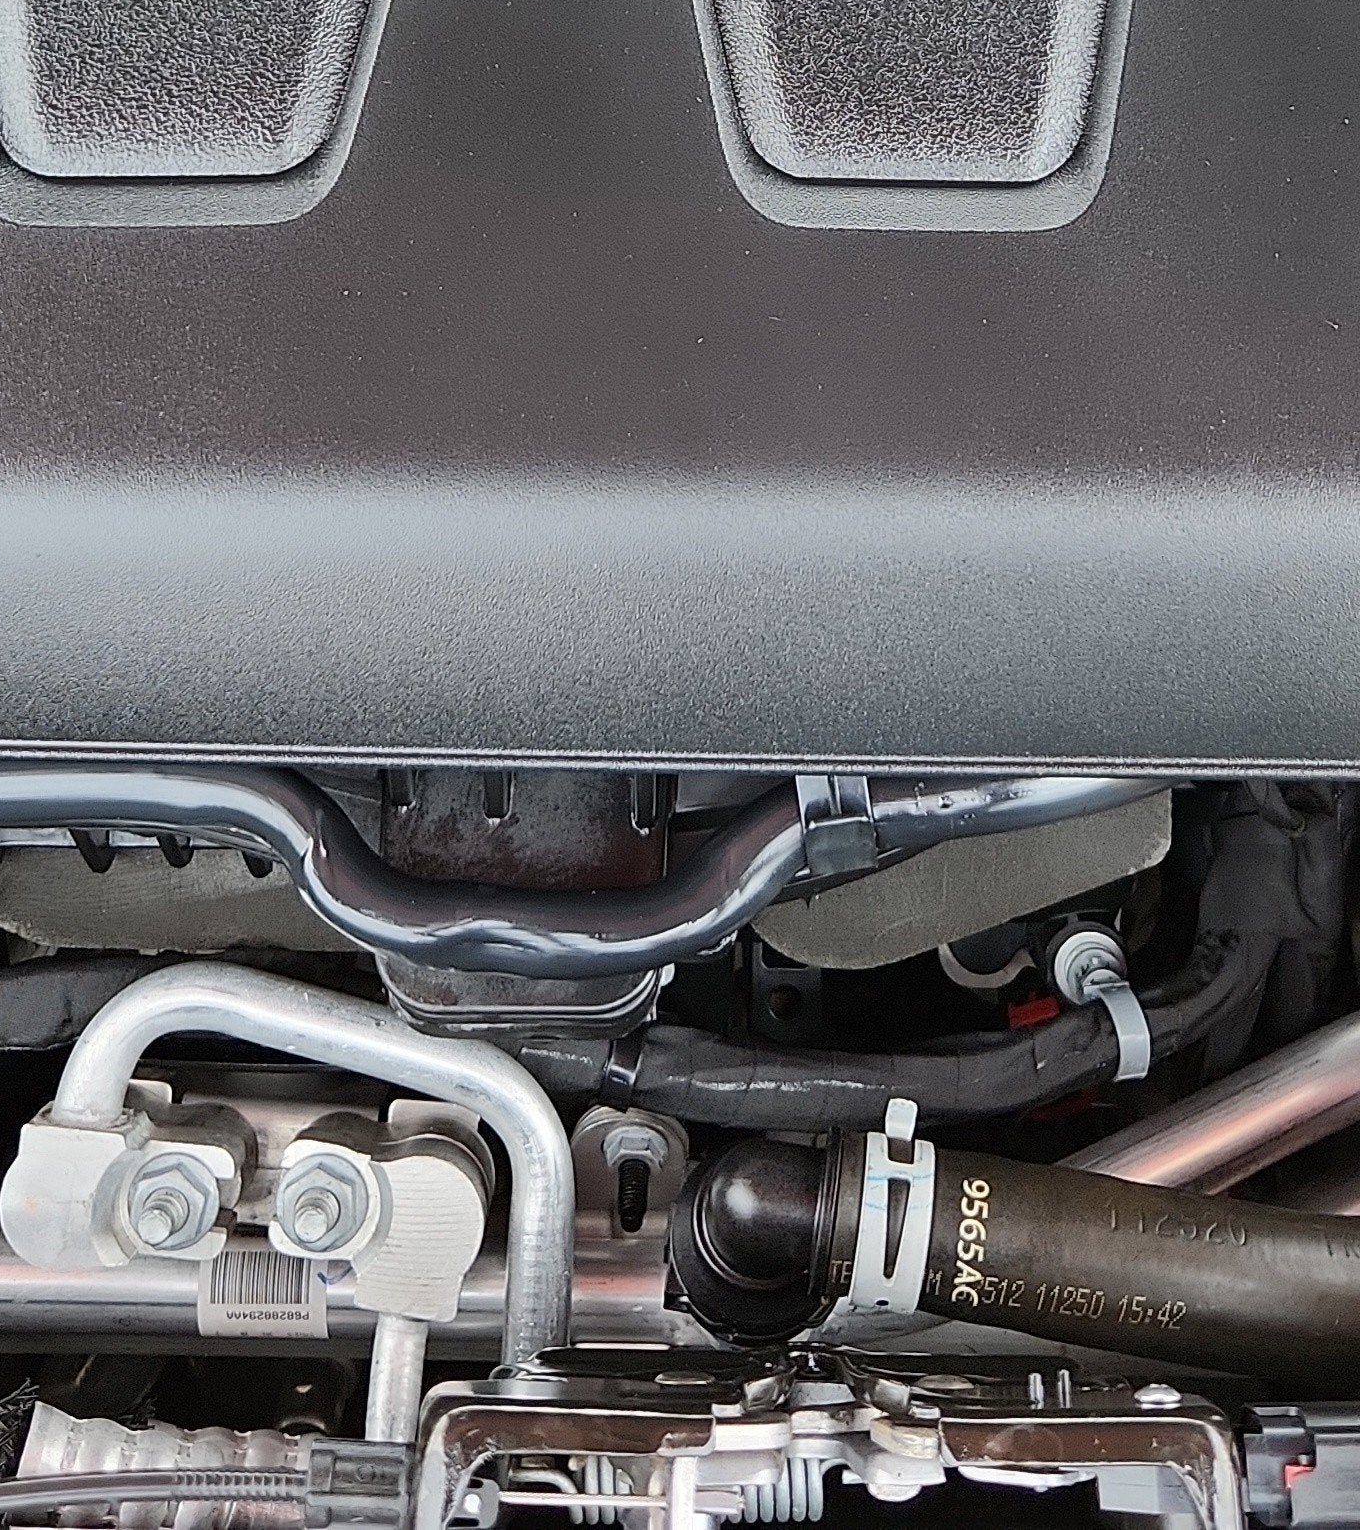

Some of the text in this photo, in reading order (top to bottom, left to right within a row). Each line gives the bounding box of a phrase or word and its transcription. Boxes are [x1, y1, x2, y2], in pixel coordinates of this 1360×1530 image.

[950, 1178, 991, 1308] 9565AC
[1036, 1281, 1106, 1322] 11250
[1116, 1293, 1188, 1331] 15:42
